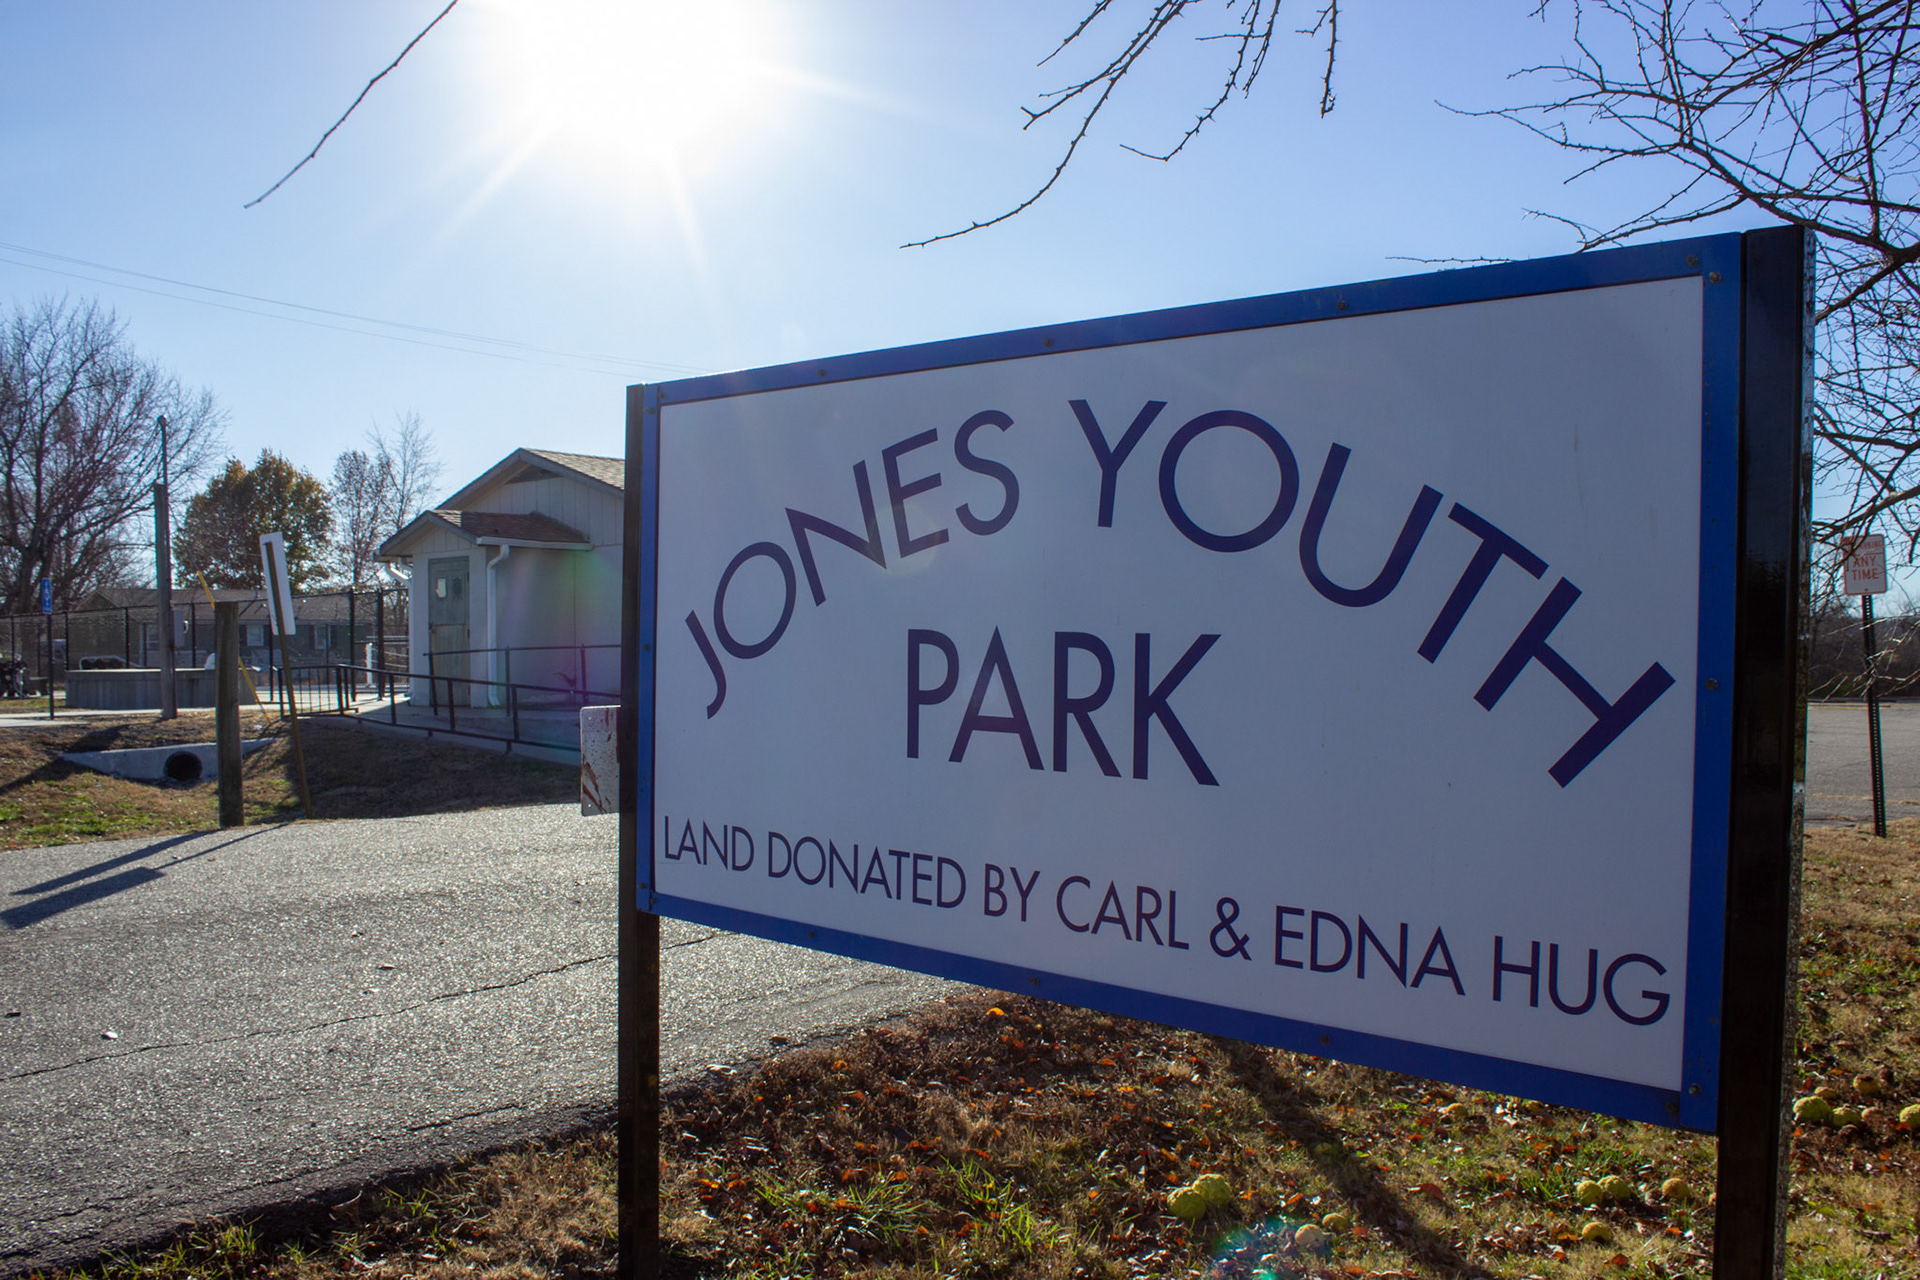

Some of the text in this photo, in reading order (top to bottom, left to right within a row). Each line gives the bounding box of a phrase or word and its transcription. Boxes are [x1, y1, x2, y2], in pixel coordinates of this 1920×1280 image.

[685, 399, 1676, 788] JONES YOUTH
[1851, 568, 1879, 580] TIME
[1853, 556, 1876, 567] ANY
[907, 625, 1222, 787] PARK
[665, 815, 1671, 1026] LAND DONATED BY CARL & EDNA HUG
